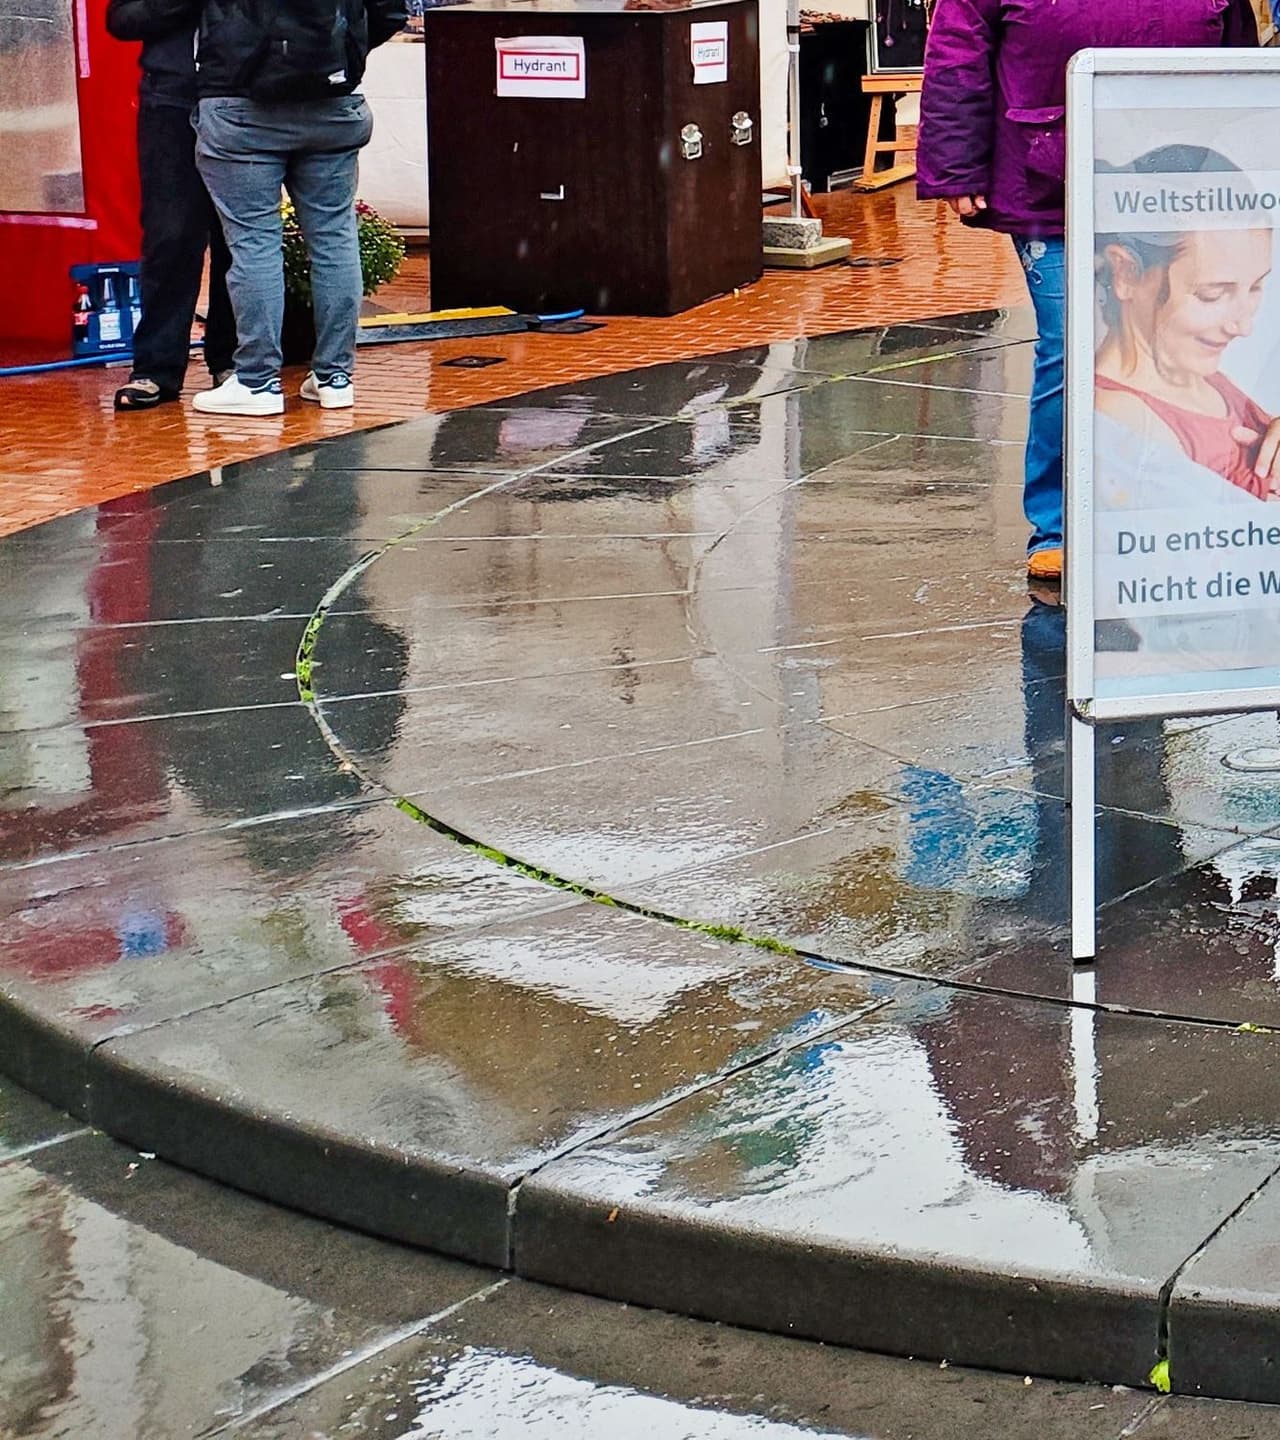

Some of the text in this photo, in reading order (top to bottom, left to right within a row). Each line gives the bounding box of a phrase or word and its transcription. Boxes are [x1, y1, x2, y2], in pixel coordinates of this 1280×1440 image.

[513, 58, 567, 75] Hydrant
[1117, 531, 1156, 555] Du
[1117, 576, 1198, 604] Nicht
[1206, 572, 1251, 598] die
